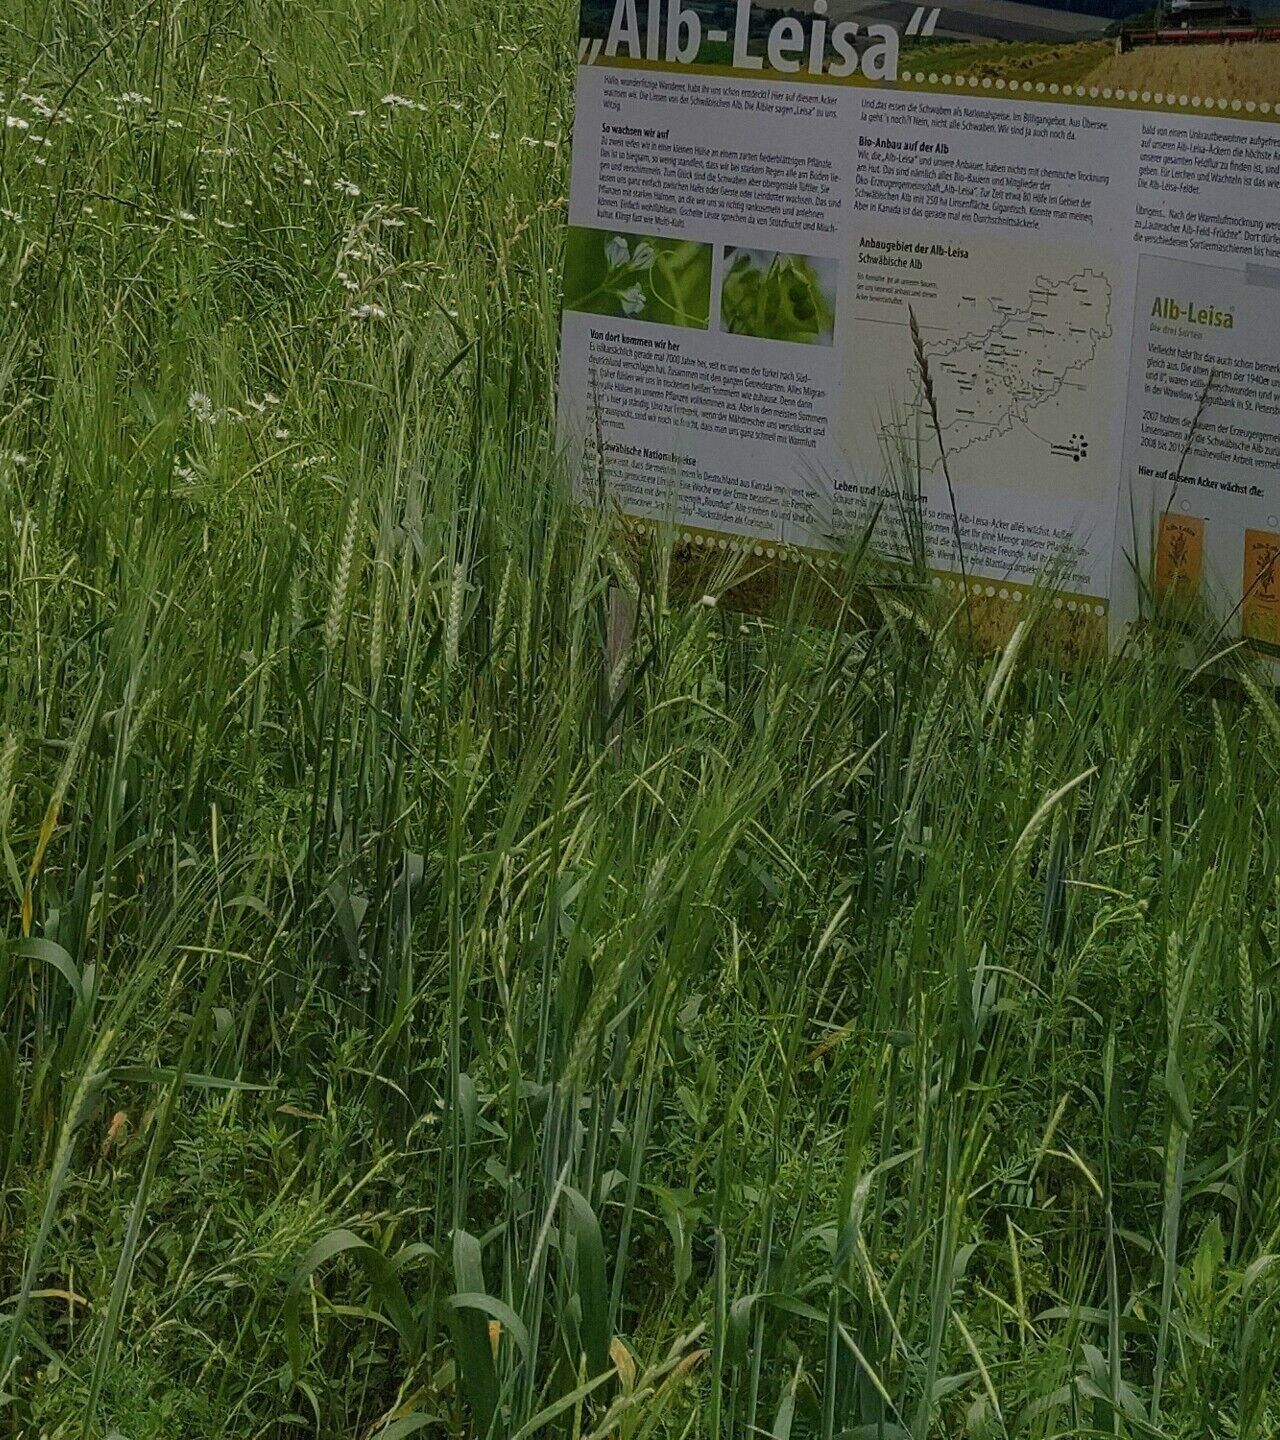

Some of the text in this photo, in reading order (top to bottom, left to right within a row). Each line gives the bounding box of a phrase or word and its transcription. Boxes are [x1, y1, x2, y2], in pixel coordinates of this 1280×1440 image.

[601, 122, 669, 139] So wachsen wir auf
[858, 135, 949, 154] Bio-Anbau auf der Alb
[858, 236, 969, 259] Anbaugebiet der Alb-Leisa
[857, 252, 923, 270] Schwäbische Alb
[1151, 295, 1234, 329] Alb-Leisa
[589, 328, 680, 351] Von dort kommen wir her
[833, 479, 858, 493] Leben
[1137, 463, 1154, 476] Hier
[1154, 466, 1168, 479] auf
[1196, 474, 1219, 488] Acker
[1219, 478, 1248, 493] wächst
[1248, 483, 1265, 496] die:
